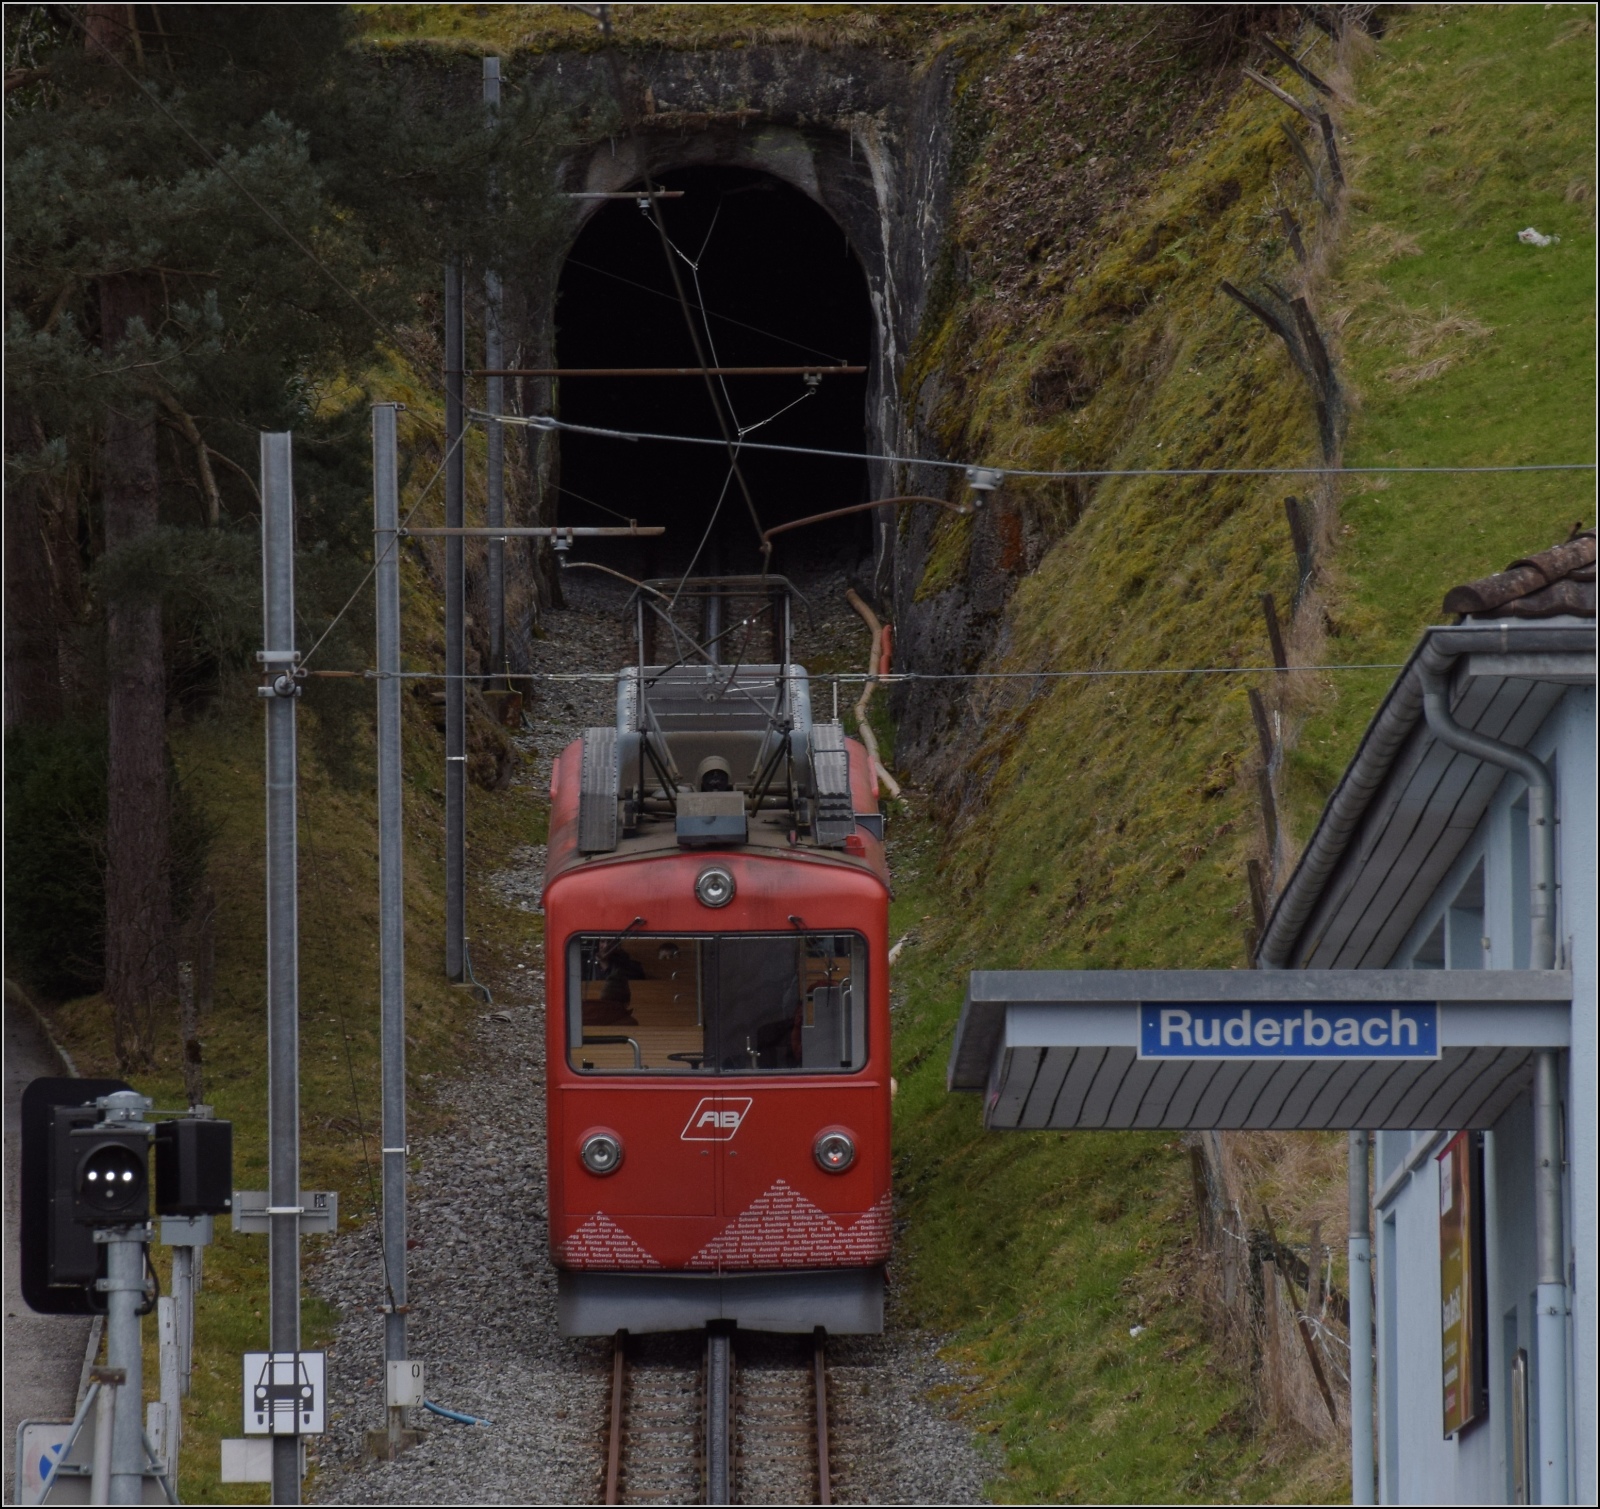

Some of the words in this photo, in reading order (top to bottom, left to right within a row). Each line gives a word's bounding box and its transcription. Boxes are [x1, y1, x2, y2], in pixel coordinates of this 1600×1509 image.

[1159, 1009, 1418, 1047] Ruderbach
[696, 1110, 742, 1128] AB
[411, 1363, 420, 1378] 0
[415, 1395, 422, 1405] 7
